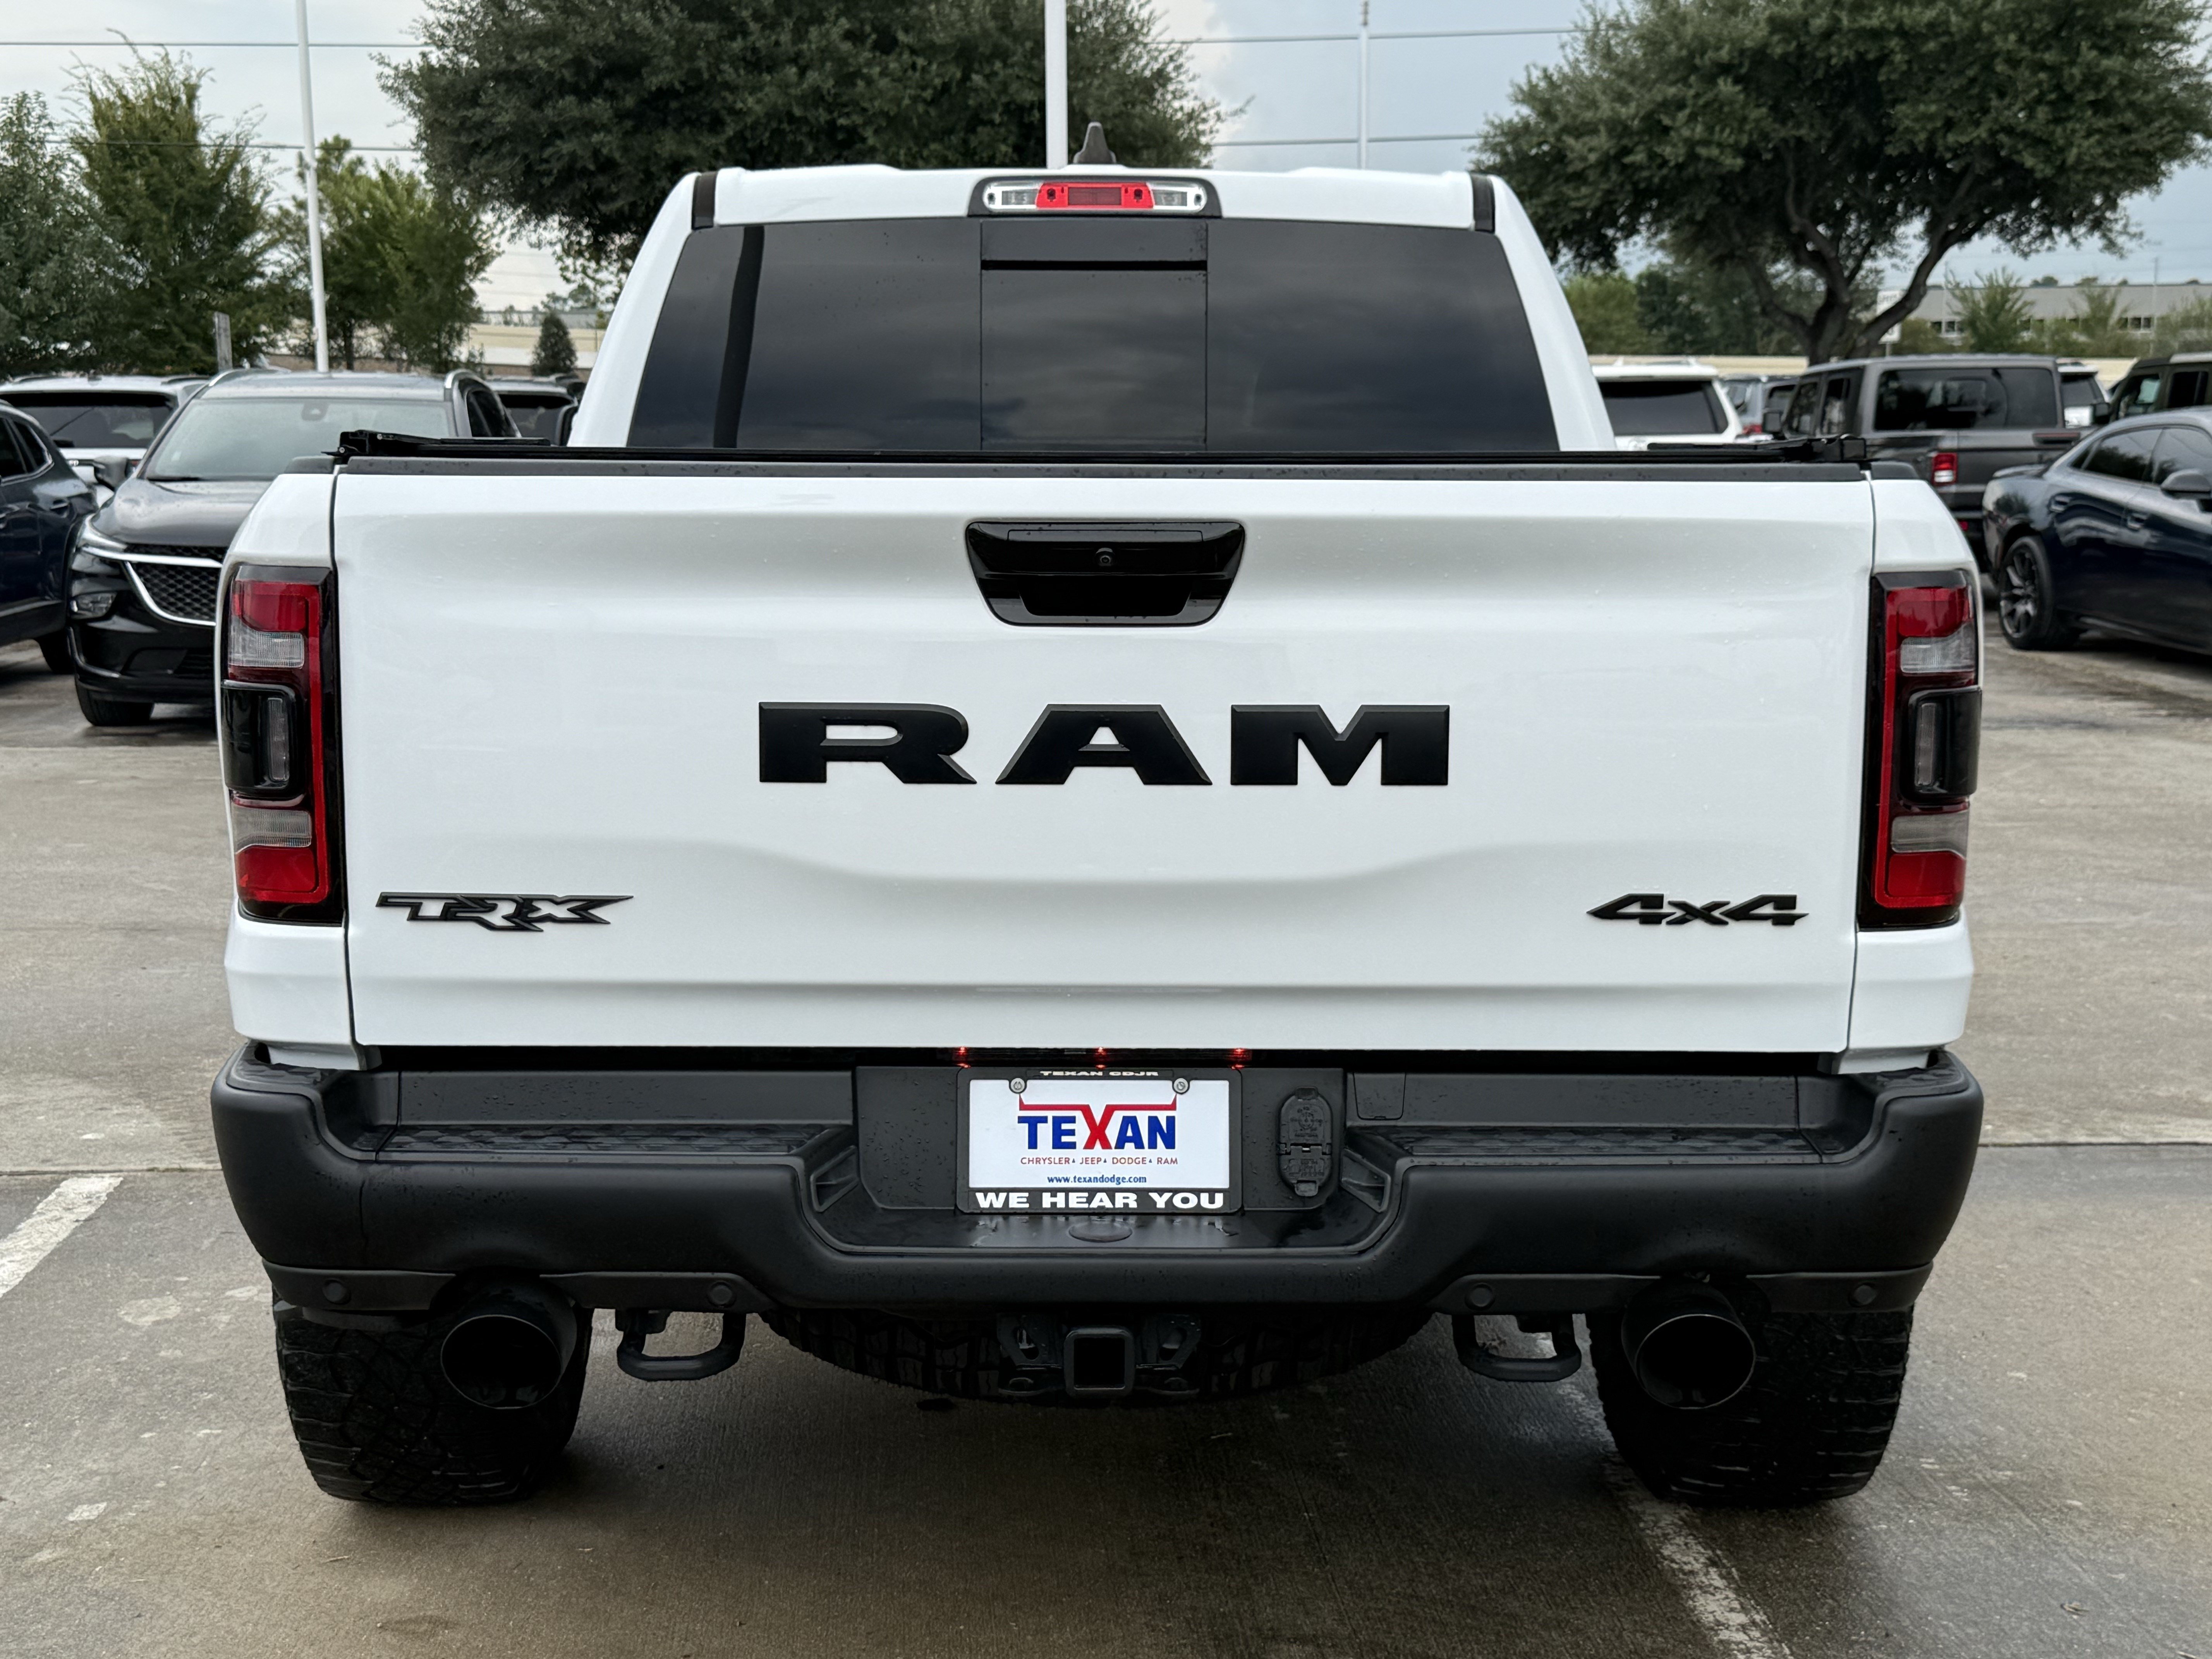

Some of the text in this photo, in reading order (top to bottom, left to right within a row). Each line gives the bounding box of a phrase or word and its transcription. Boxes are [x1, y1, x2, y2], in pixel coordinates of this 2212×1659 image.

[759, 702, 1450, 786] RAM
[376, 891, 634, 933] TRX
[1586, 893, 1809, 926] 4x4
[1017, 1104, 1176, 1149] TEXAN
[1047, 1174, 1147, 1185] www.texandodge.com
[975, 1192, 1224, 1209] WE HEAR YOU
